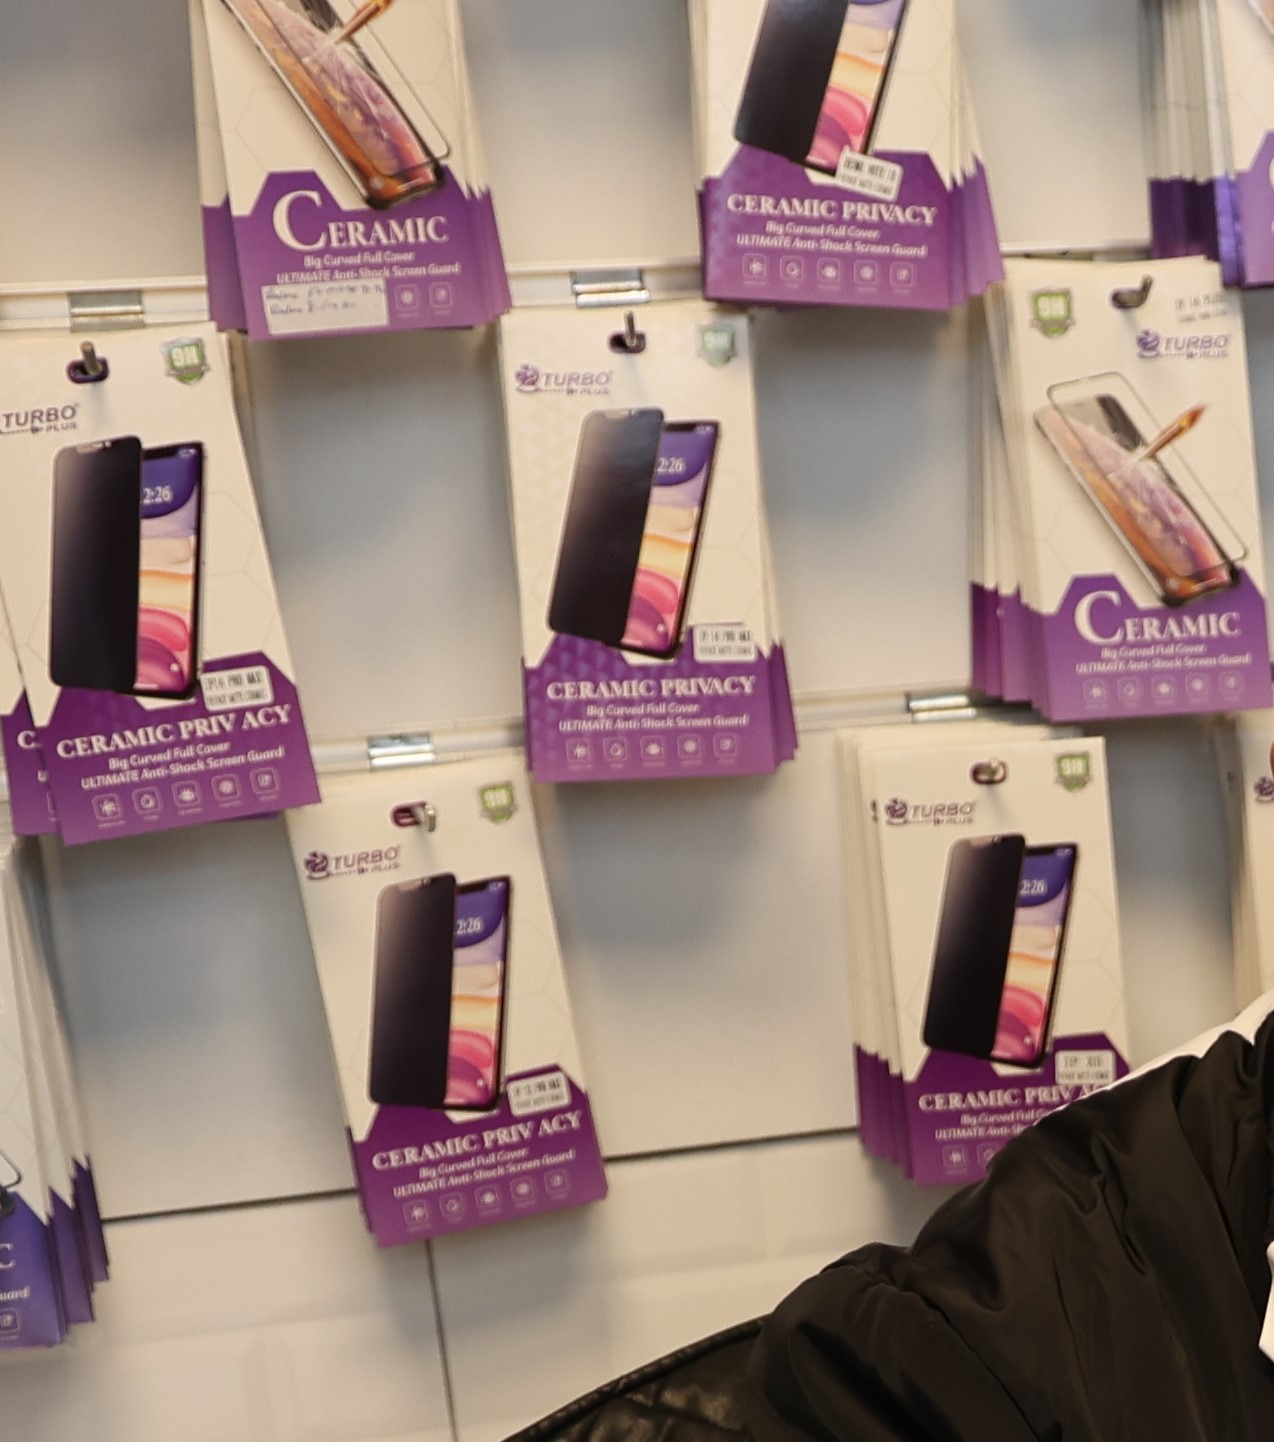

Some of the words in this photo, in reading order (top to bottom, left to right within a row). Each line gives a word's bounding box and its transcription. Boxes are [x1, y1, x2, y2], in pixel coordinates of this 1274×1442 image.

[273, 190, 449, 251] CERAMIC
[727, 193, 837, 219] CERAMIC
[842, 201, 938, 226] PRIVACY
[848, 227, 880, 240] Cover
[736, 234, 791, 249] ULTIMATE
[854, 241, 890, 255] Screen
[891, 243, 928, 257] Guard
[276, 271, 331, 284] ULTIMATE
[428, 262, 461, 274] Guard
[1161, 335, 1229, 350] TURBO
[543, 371, 610, 386] TURBO
[2, 405, 77, 428] TURBO
[46, 422, 78, 432] PLUS
[656, 457, 686, 474] 2:26
[141, 485, 173, 504] 2:26
[1074, 590, 1241, 645] CERAMIC
[546, 679, 657, 700] CERAMIC
[659, 675, 757, 697] PRIVACY
[586, 705, 604, 718] Big
[606, 704, 645, 716] Curved
[646, 703, 666, 713] Full
[667, 703, 699, 713] Cover
[558, 718, 613, 732] ULTIMATE
[675, 716, 712, 727] Screen
[713, 714, 749, 726] Guard
[56, 724, 174, 758] CERAMIC
[108, 757, 128, 770] Big
[129, 751, 171, 767] Curved
[173, 747, 195, 760] Full
[196, 741, 230, 755] Cover
[80, 772, 139, 790] ULTIMATE
[206, 755, 245, 769] Screen
[247, 746, 285, 761] Guard
[911, 802, 975, 818] TURBO
[333, 847, 399, 870] TURBO
[1019, 879, 1047, 895] 2:26
[454, 917, 482, 934] 2:26
[918, 1088, 1021, 1112] CERAMIC
[372, 1134, 479, 1170] CERAMIC
[0, 1286, 31, 1300] uard
